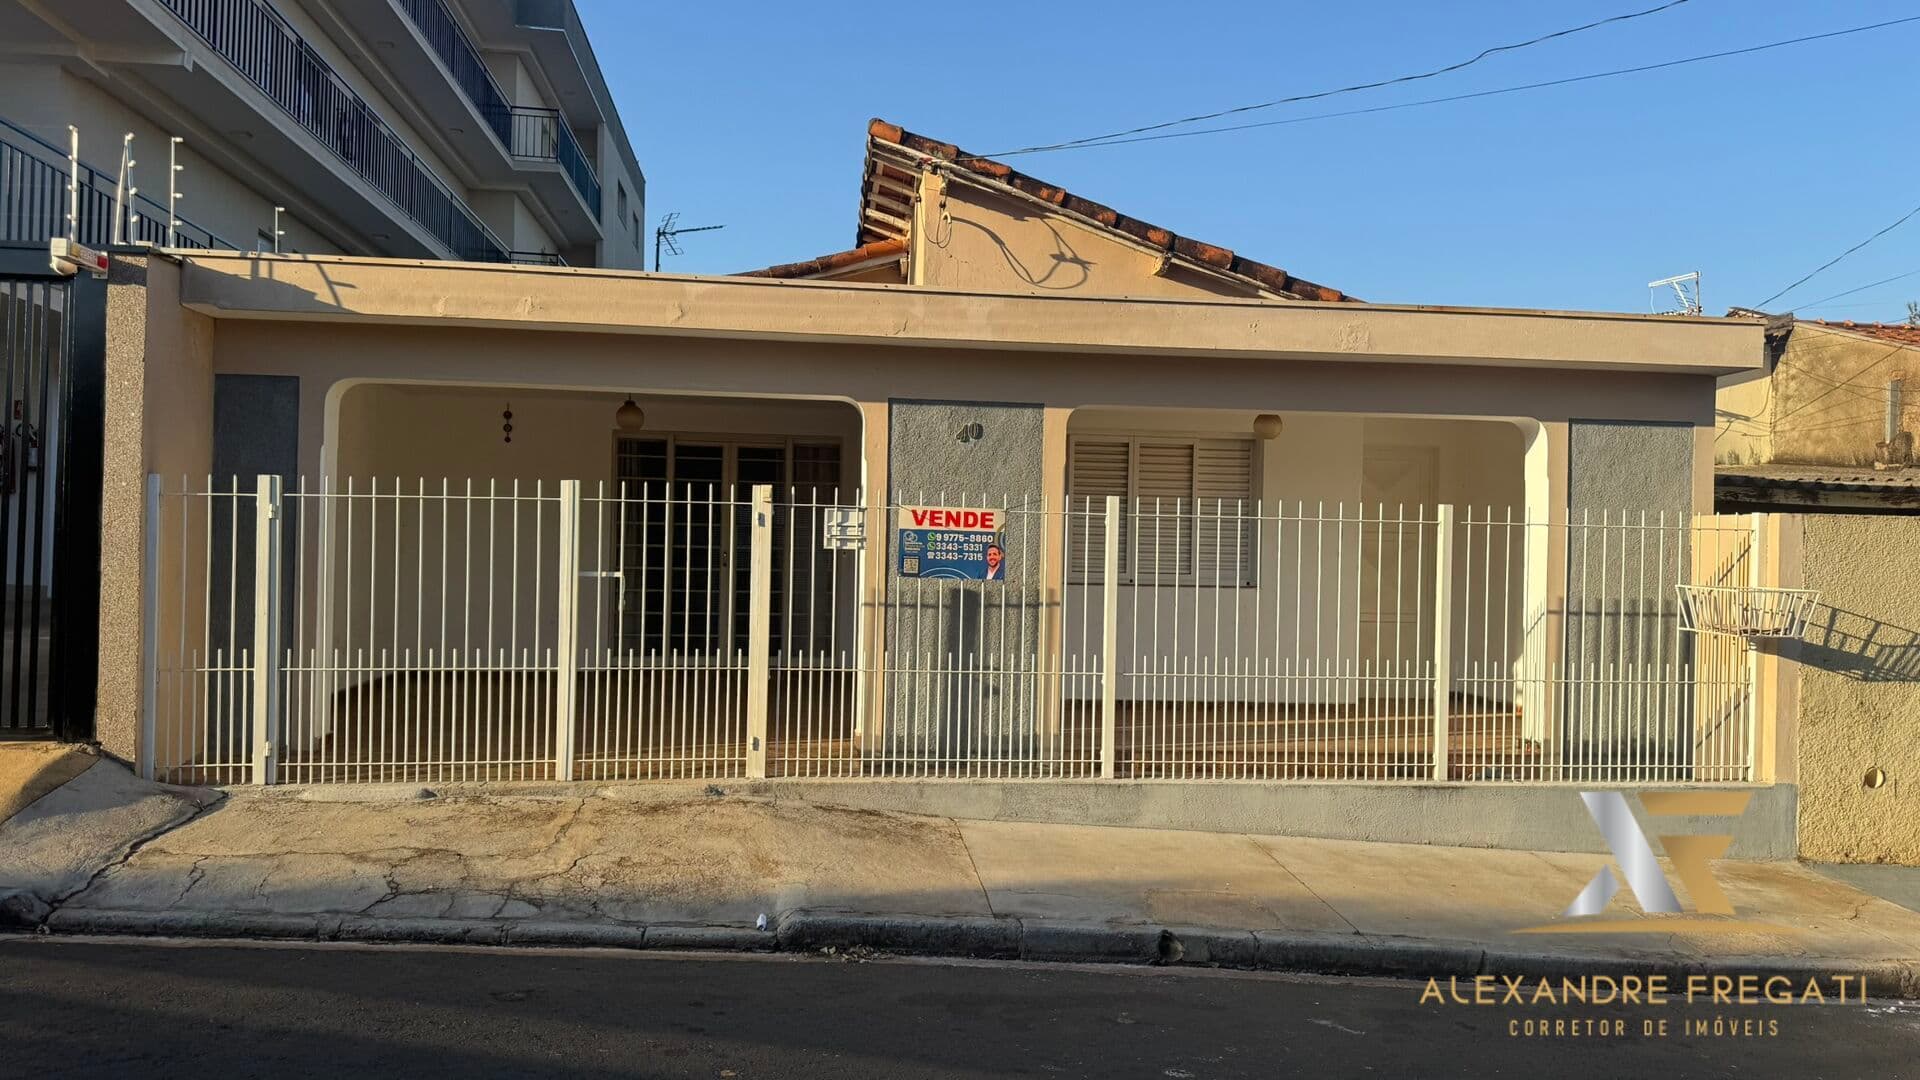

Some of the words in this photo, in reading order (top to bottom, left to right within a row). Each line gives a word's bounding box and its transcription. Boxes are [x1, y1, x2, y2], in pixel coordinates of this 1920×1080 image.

[955, 422, 983, 443] 40
[911, 509, 994, 528] VENDE
[935, 542, 983, 551] 3343-5331
[935, 552, 983, 561] 3343-7315
